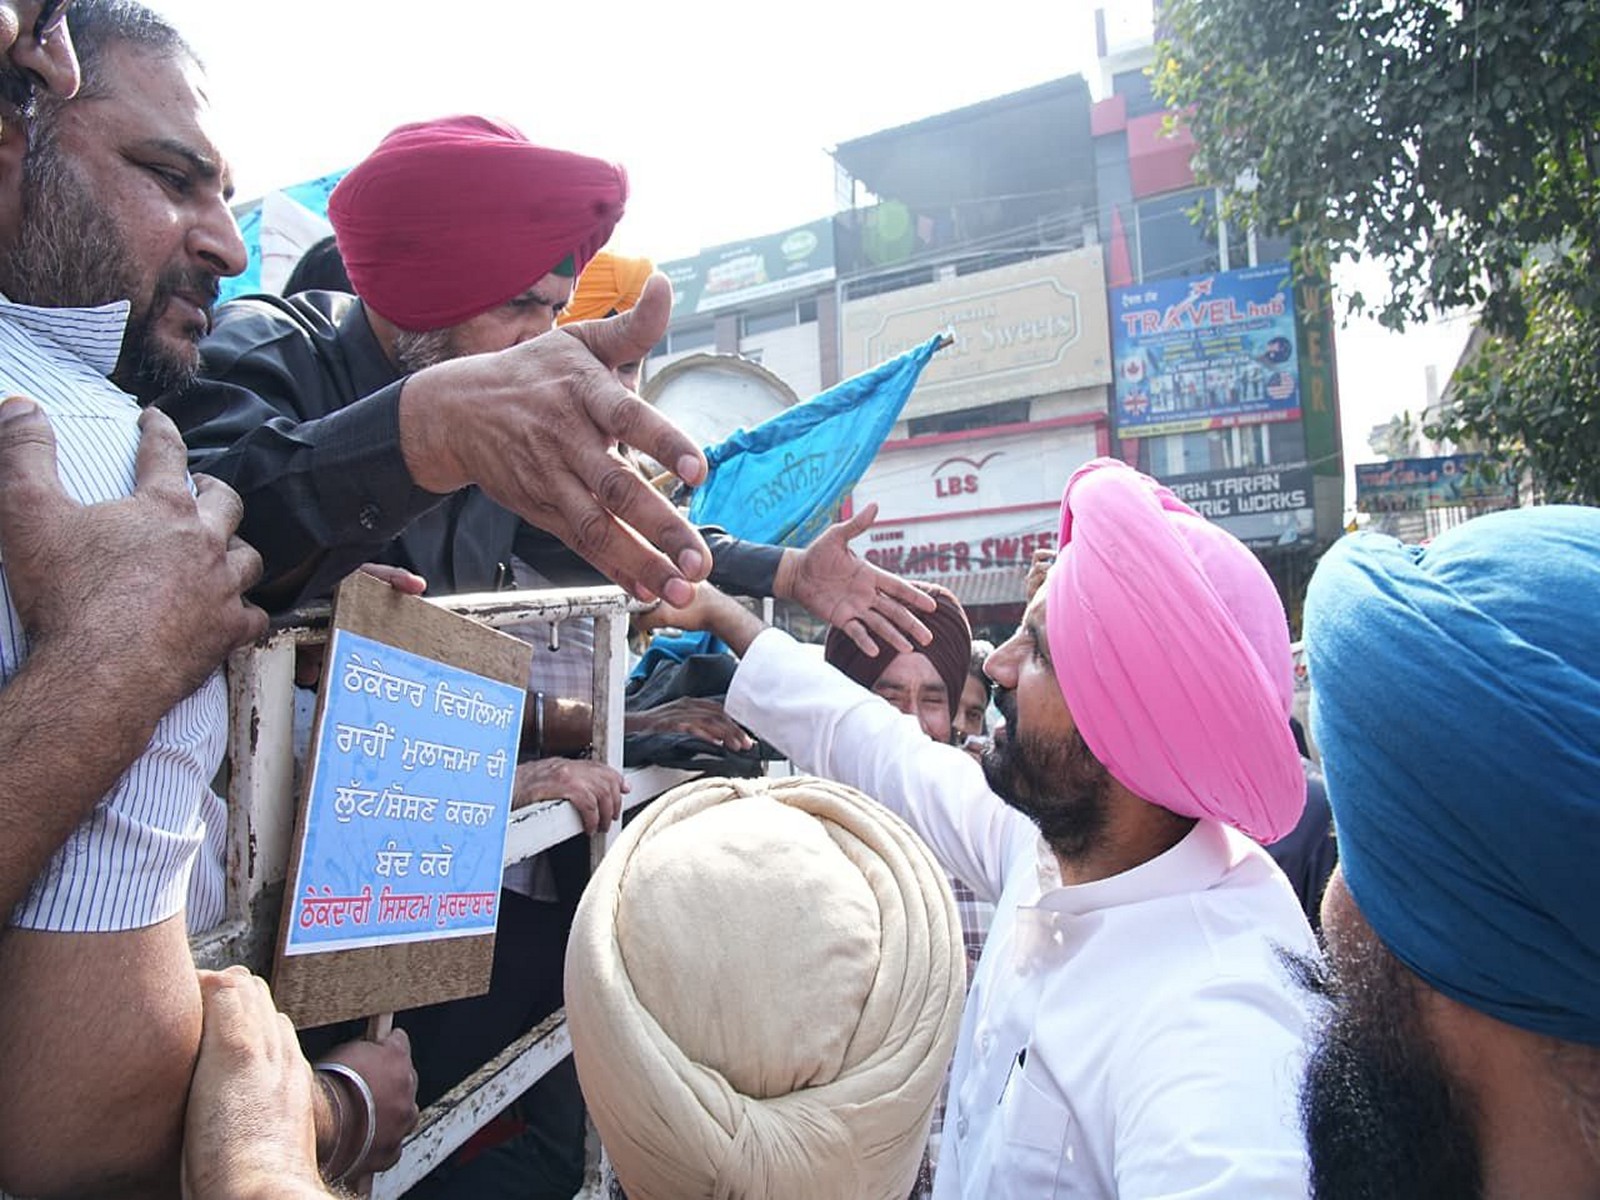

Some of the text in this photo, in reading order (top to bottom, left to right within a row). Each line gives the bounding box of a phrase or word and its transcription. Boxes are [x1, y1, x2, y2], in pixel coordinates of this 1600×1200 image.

[979, 313, 1071, 350] Sweets
[1121, 296, 1243, 337] TRAVEL
[1248, 296, 1285, 317] hub
[935, 475, 979, 498] LBS
[1211, 473, 1280, 497] TARAN
[1238, 490, 1306, 513] WORKS
[980, 531, 1058, 570] SWEE
[343, 653, 516, 729] ਠੇਕੇਦਾਰ ਵਿਚੋਲਿਆਂ
[336, 722, 395, 759] ਰਾਹੀਂ
[487, 747, 508, 779] ਦੀ
[445, 799, 496, 826] ਕਰਨਾ
[376, 841, 453, 878] ਬੰਦ ਕਰੋ
[300, 885, 497, 928] ਠੇਕੇਦਾਰੀ ਸਿਸਟਮ ਮੁਰਦਾਬਾਦ
